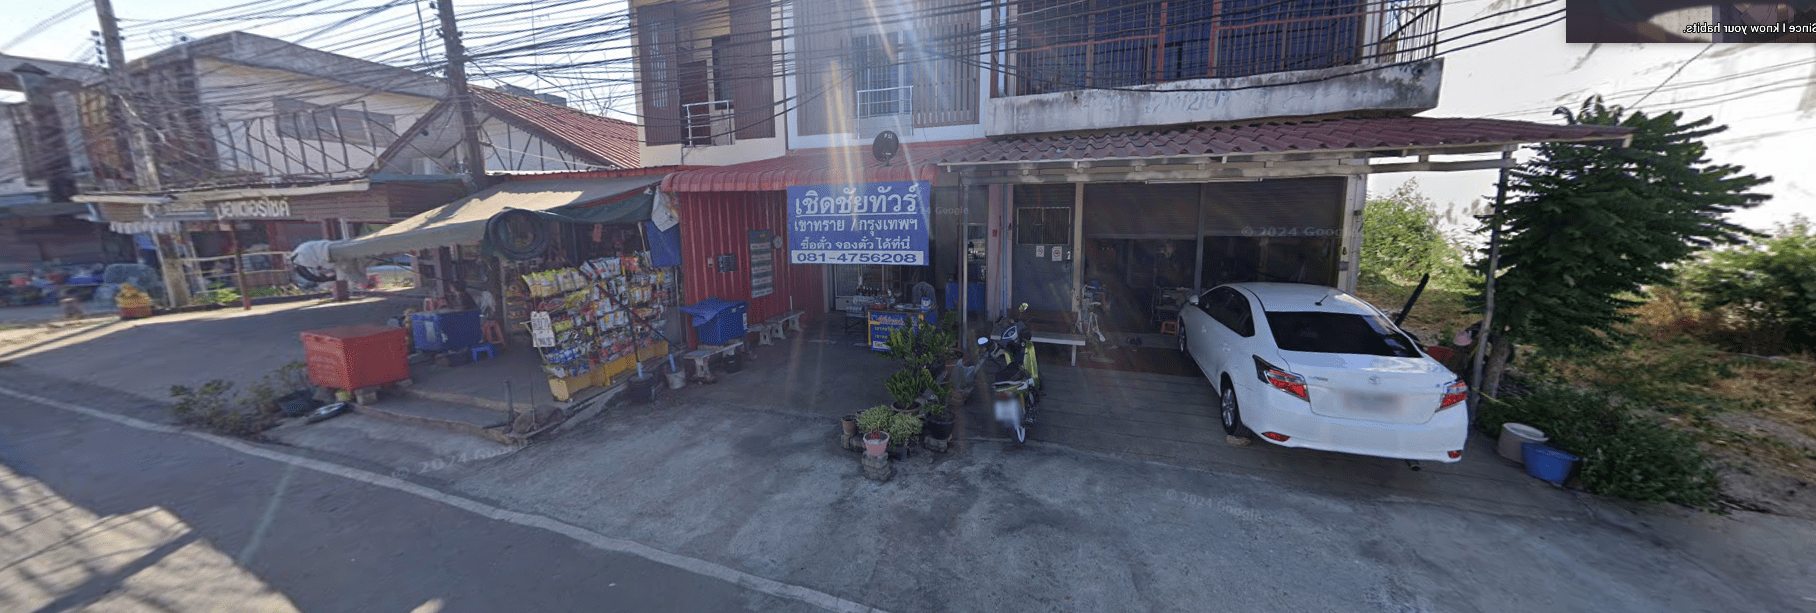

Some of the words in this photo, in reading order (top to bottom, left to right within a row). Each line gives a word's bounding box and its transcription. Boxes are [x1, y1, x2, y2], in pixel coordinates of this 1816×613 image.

[795, 182, 919, 215] เชิดชัยทัวร์
[794, 219, 845, 232] เขาทราย
[859, 218, 918, 236] กรุงเทพฯ
[797, 252, 917, 264] 081-4756208
